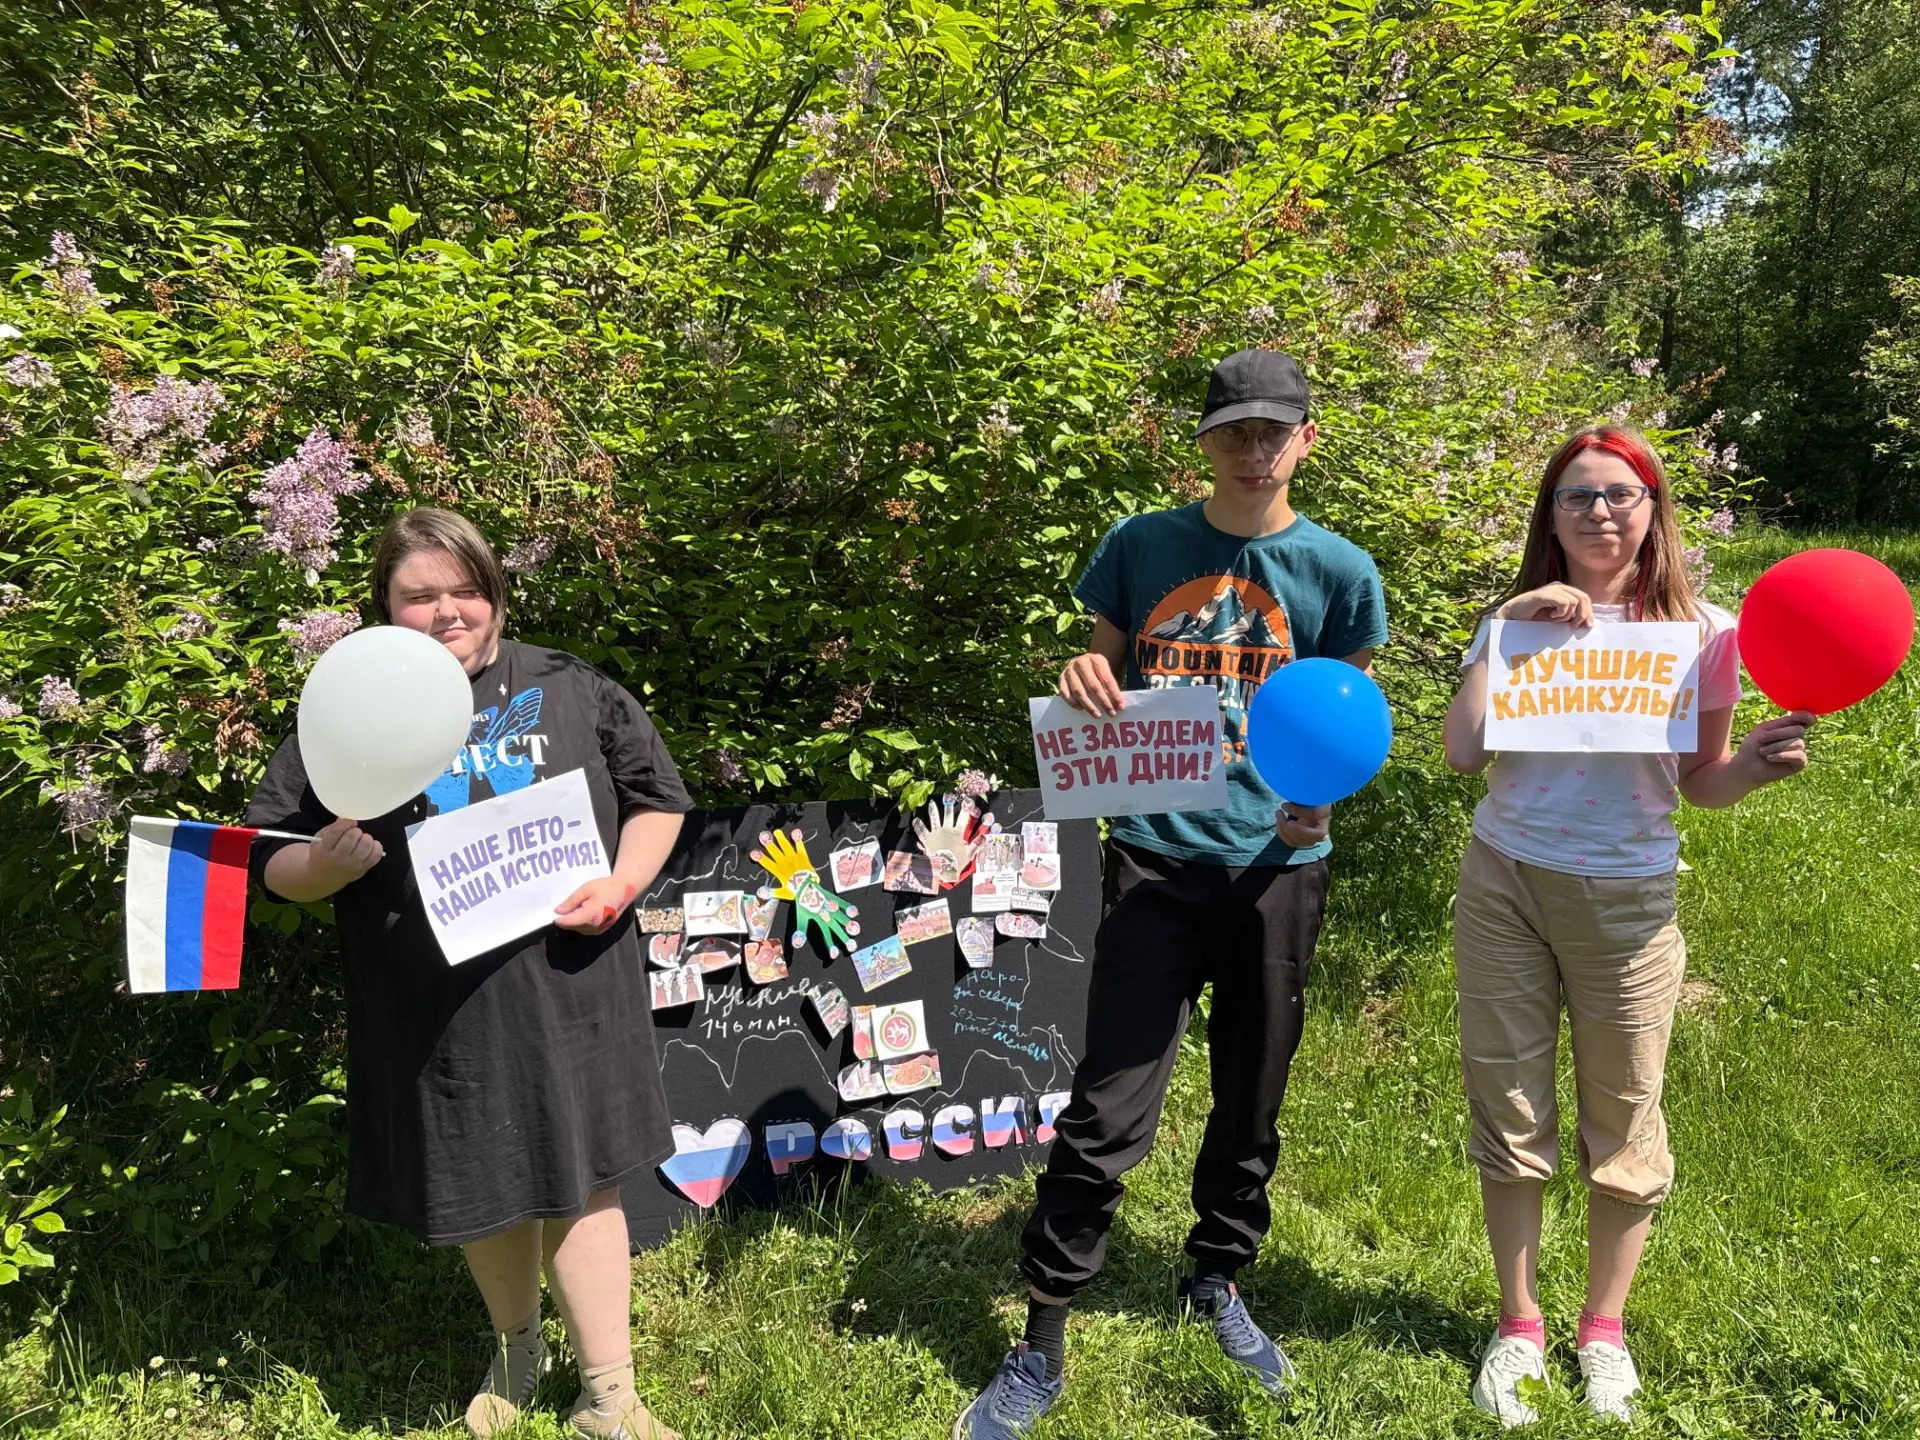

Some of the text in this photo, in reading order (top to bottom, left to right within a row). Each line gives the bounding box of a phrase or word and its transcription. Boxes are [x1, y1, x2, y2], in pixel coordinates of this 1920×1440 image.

[1509, 648, 1678, 685] ЛУЧШИЕ
[1492, 685, 1694, 721] КАНИКУЛЫ!
[1036, 727, 1078, 760] НЕ
[1081, 720, 1215, 753] ЗАБУДЕМ
[1050, 754, 1119, 791] ЭТИ
[1128, 752, 1212, 785] ДНИ!
[429, 833, 501, 890] НАШЕ
[430, 840, 601, 926] НАША ИСТОРИЯ!
